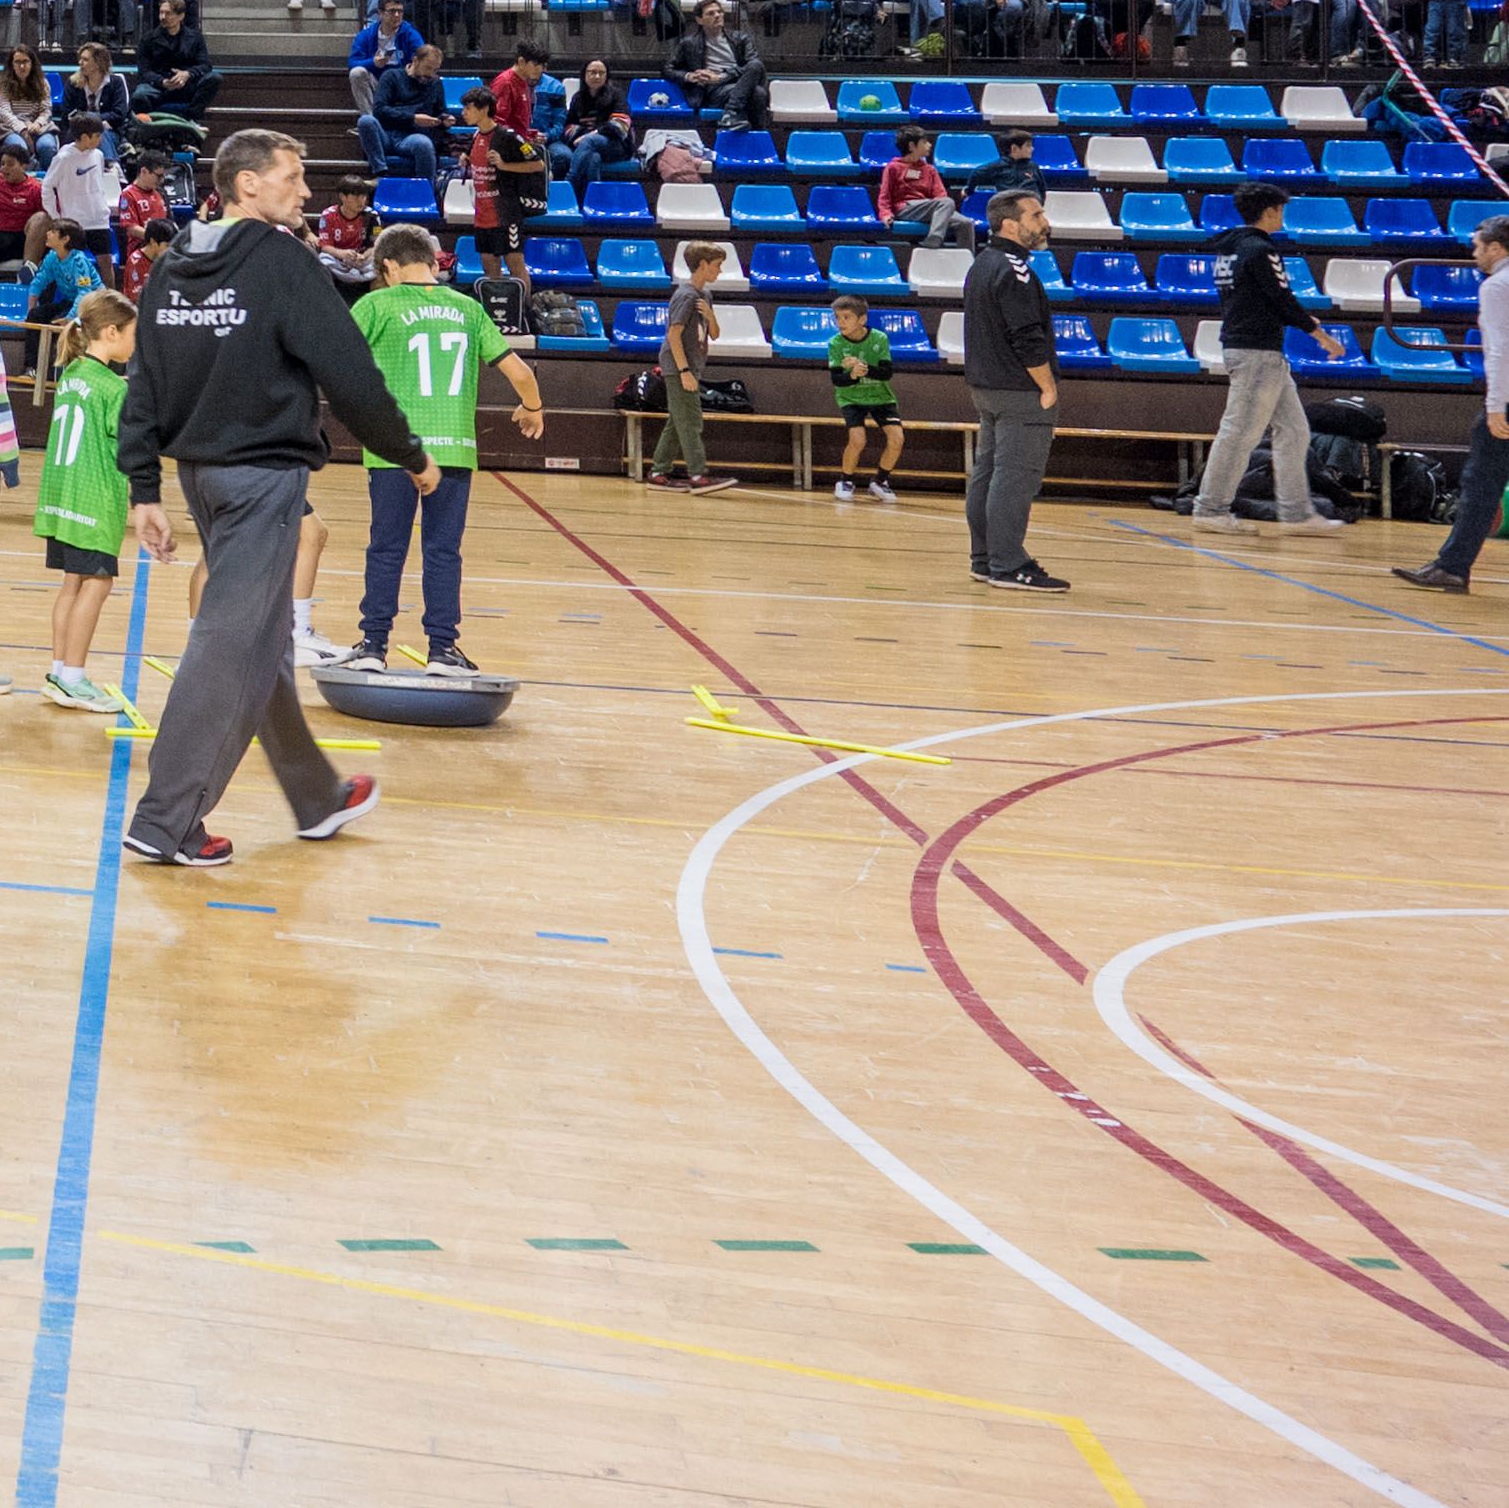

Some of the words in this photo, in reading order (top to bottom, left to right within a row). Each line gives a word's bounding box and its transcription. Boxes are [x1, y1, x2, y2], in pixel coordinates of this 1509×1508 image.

[401, 308, 418, 326] LA
[418, 305, 465, 325] MIRADA
[408, 332, 469, 397] 17
